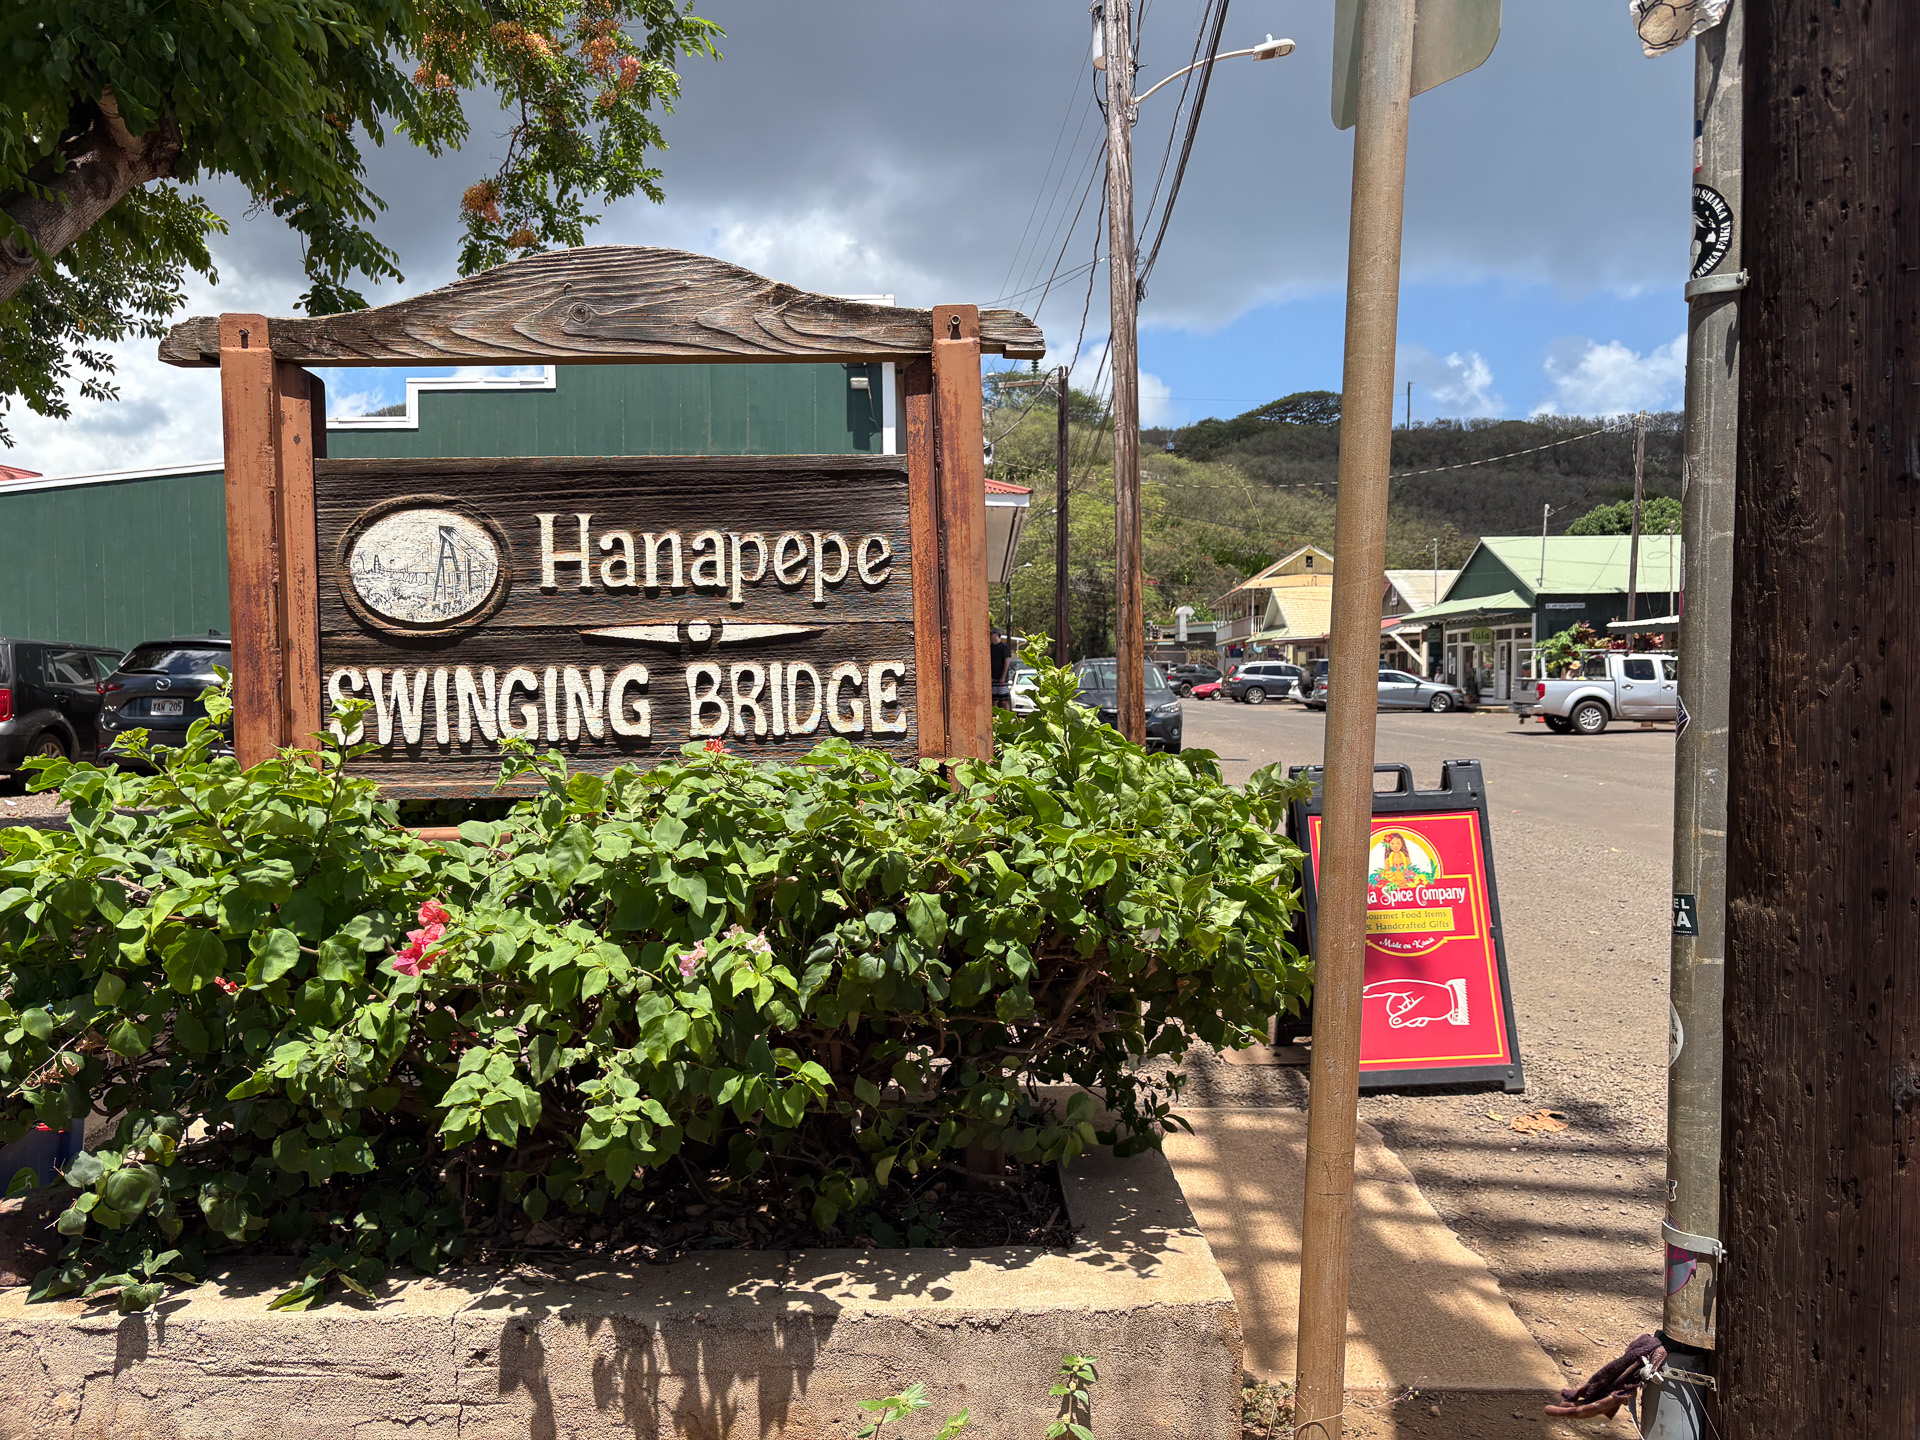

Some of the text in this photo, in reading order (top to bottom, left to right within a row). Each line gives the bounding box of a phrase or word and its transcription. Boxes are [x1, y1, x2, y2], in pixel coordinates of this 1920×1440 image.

[1700, 189, 1728, 220] SHAKA
[1716, 221, 1730, 250] FAKA
[535, 513, 893, 608] Hanapepe
[169, 701, 182, 712] 205
[327, 661, 908, 746] SWINGING BRIDGE
[1380, 886, 1413, 907] Spice
[1416, 885, 1465, 906] Company
[1367, 910, 1447, 920] ourmet Food Items
[1376, 922, 1426, 931] Handcrafted
[1429, 921, 1450, 929] Gifts
